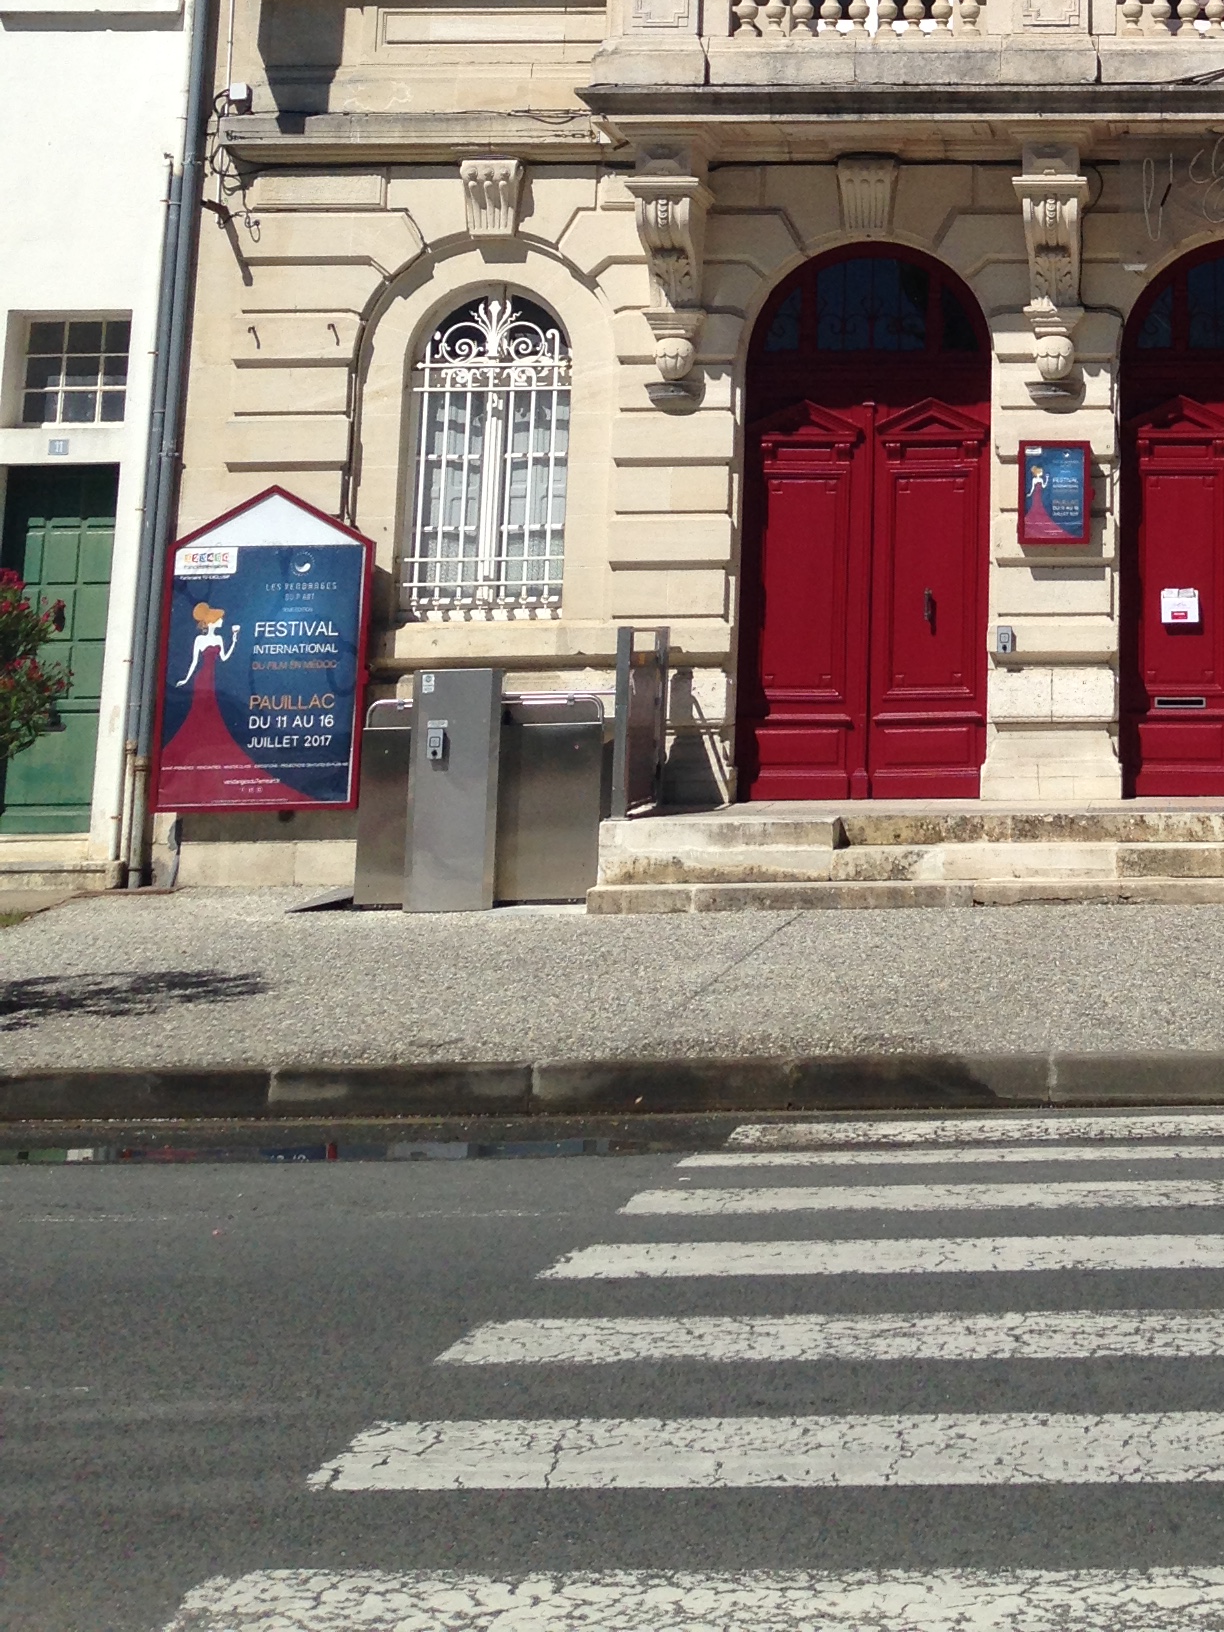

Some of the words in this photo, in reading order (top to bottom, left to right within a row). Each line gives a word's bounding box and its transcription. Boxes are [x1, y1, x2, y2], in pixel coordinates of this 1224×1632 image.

[54, 440, 64, 454] 11
[265, 583, 282, 592] LES
[254, 621, 339, 637] FESTIVAL
[253, 643, 339, 655] INTERNATIONAL
[249, 693, 336, 710] PAUILLAC
[249, 715, 271, 729] DU
[275, 715, 288, 728] 11
[292, 714, 314, 728] AU
[319, 714, 335, 728] 16
[247, 735, 300, 748] JUILLET
[303, 734, 332, 747] 2017
